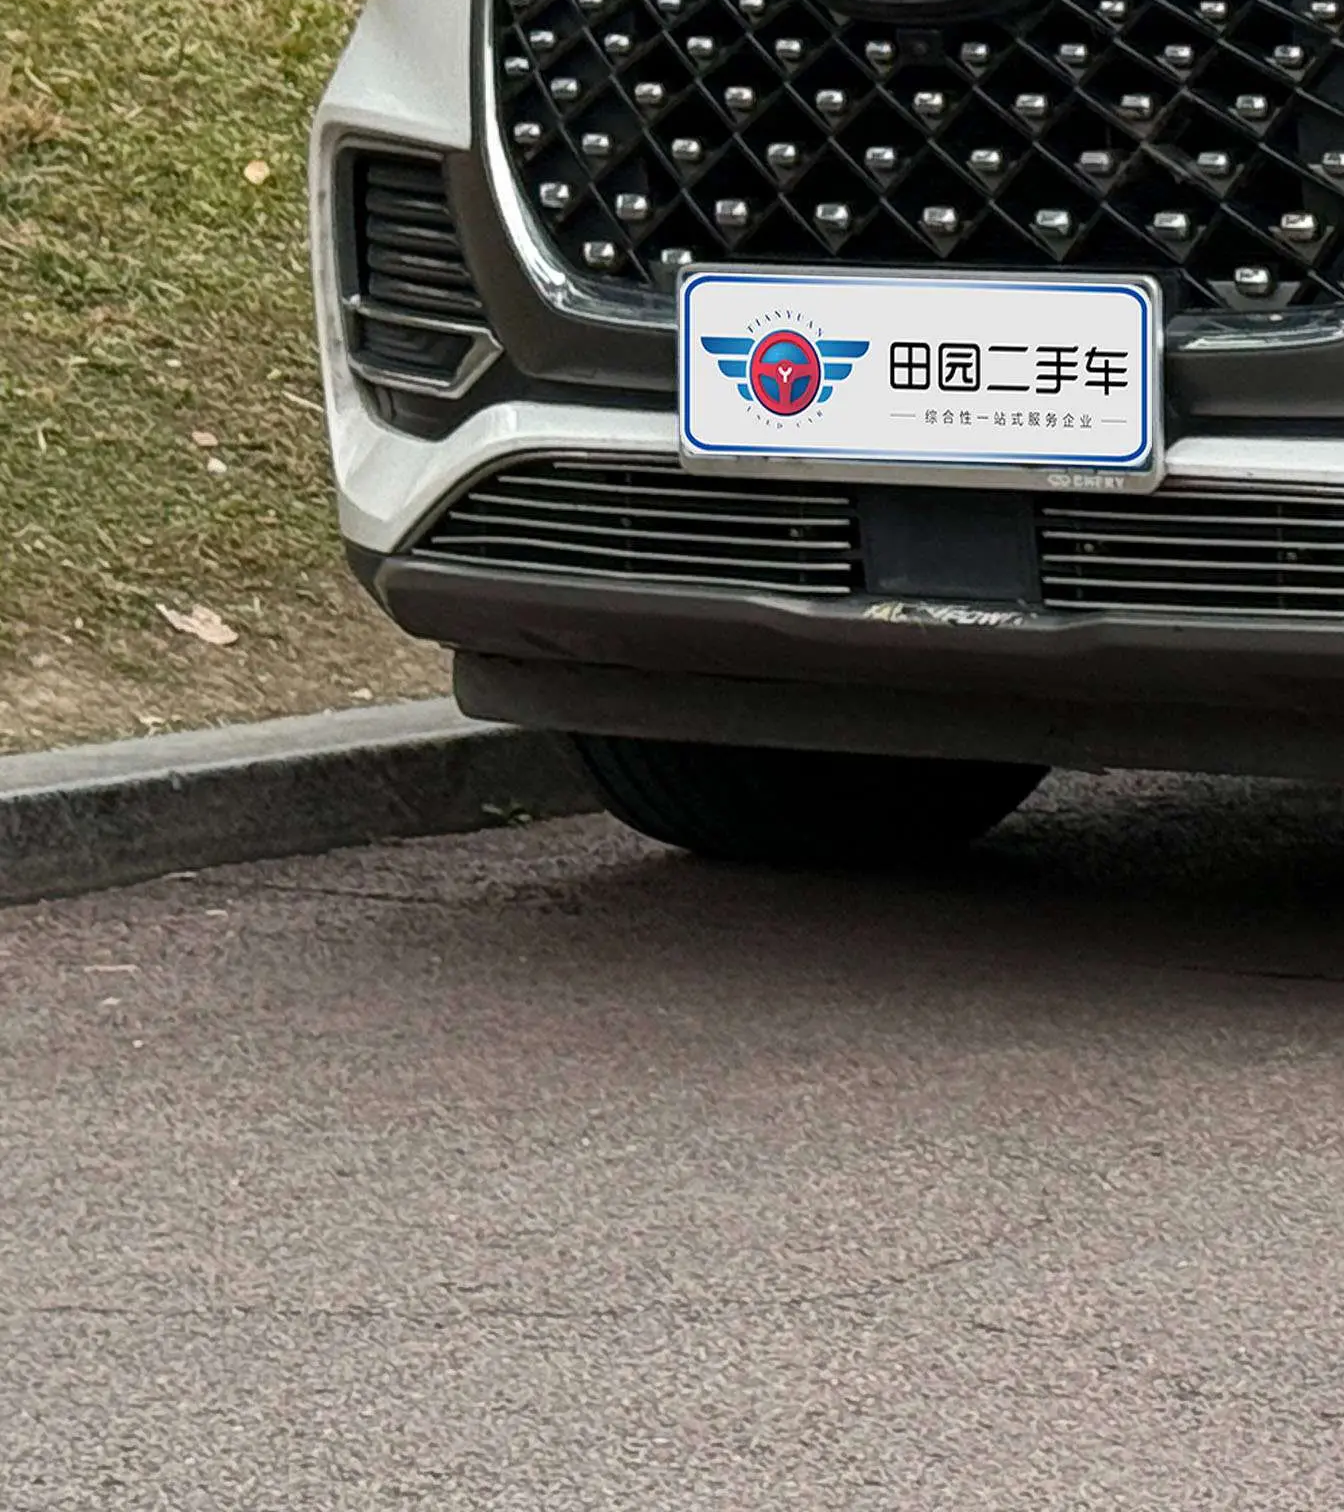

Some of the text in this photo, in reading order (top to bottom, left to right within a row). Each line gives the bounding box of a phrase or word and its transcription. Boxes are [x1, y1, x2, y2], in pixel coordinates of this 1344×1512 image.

[889, 341, 1129, 396] 田园二手车
[924, 408, 1093, 429] 综合性一站式服务企业
